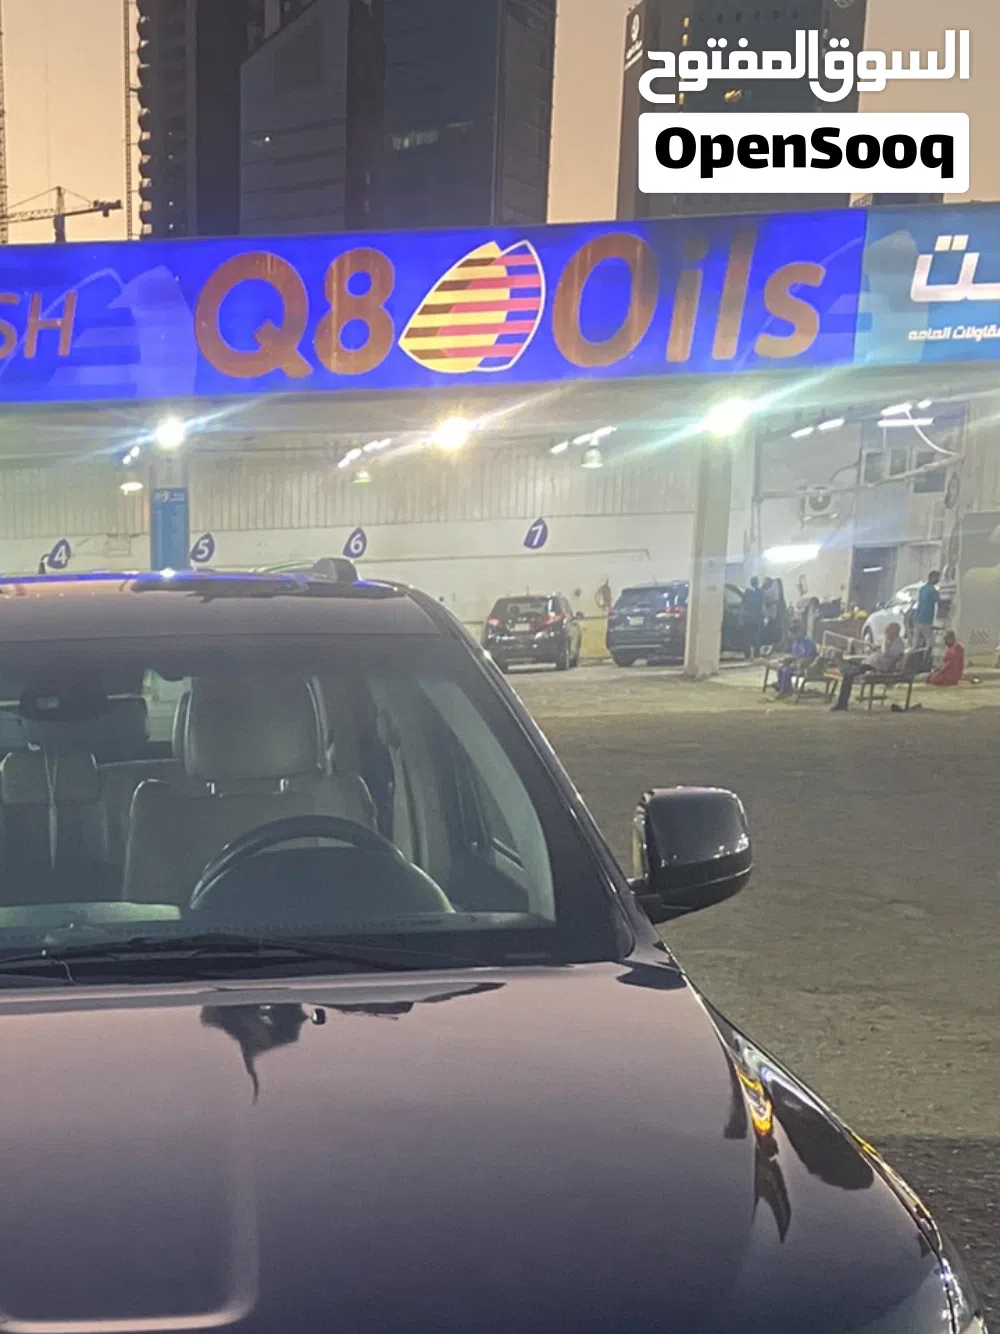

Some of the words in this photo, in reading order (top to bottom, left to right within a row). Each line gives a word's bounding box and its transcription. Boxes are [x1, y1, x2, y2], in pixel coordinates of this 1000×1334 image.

[193, 246, 396, 379] Q8
[551, 226, 827, 369] Oils
[349, 533, 364, 554] 6
[531, 524, 544, 547] 7
[53, 545, 67, 565] 4
[196, 539, 210, 559] 5
